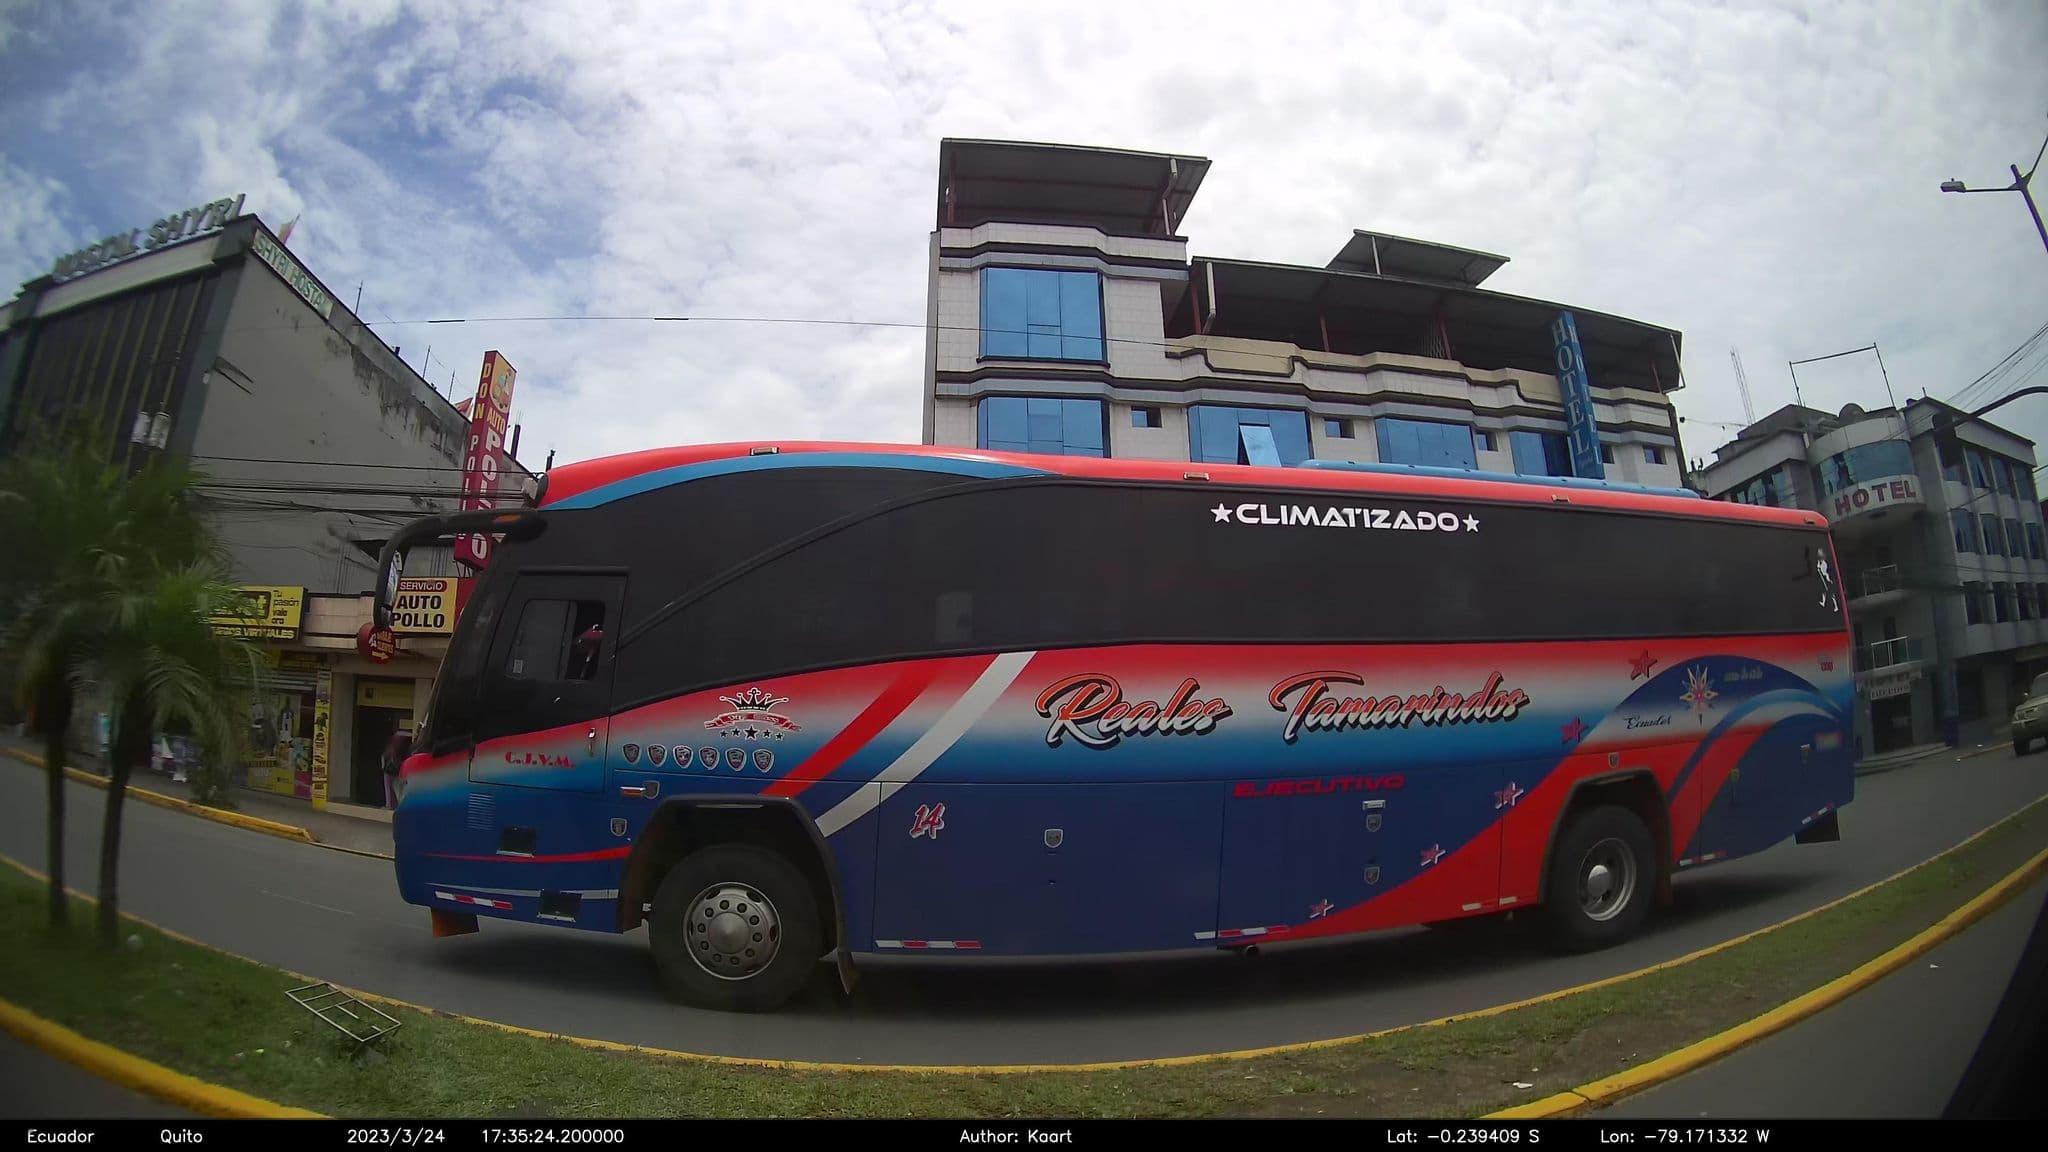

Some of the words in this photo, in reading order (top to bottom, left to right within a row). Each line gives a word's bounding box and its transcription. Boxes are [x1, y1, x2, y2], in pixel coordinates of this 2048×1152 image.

[254, 232, 289, 278] SHYRI
[287, 262, 330, 310] HOSTA
[474, 362, 491, 420] DON
[1551, 319, 1590, 455] HOTEL
[1567, 325, 1602, 465] HOTEL
[486, 408, 506, 435] AUTO
[457, 434, 480, 540] POL
[471, 431, 502, 560] POLO
[1833, 478, 1917, 517] HOTEL
[1236, 503, 1460, 532] CLIMATIZADO
[395, 594, 442, 610] AUTO
[399, 580, 444, 592] SERVICIO
[390, 612, 445, 629] POLLO
[1035, 672, 1233, 750] Reales
[1268, 670, 1530, 745] Tamarindos
[1233, 773, 1406, 798] EJECUTIVO
[909, 803, 946, 840] 14
